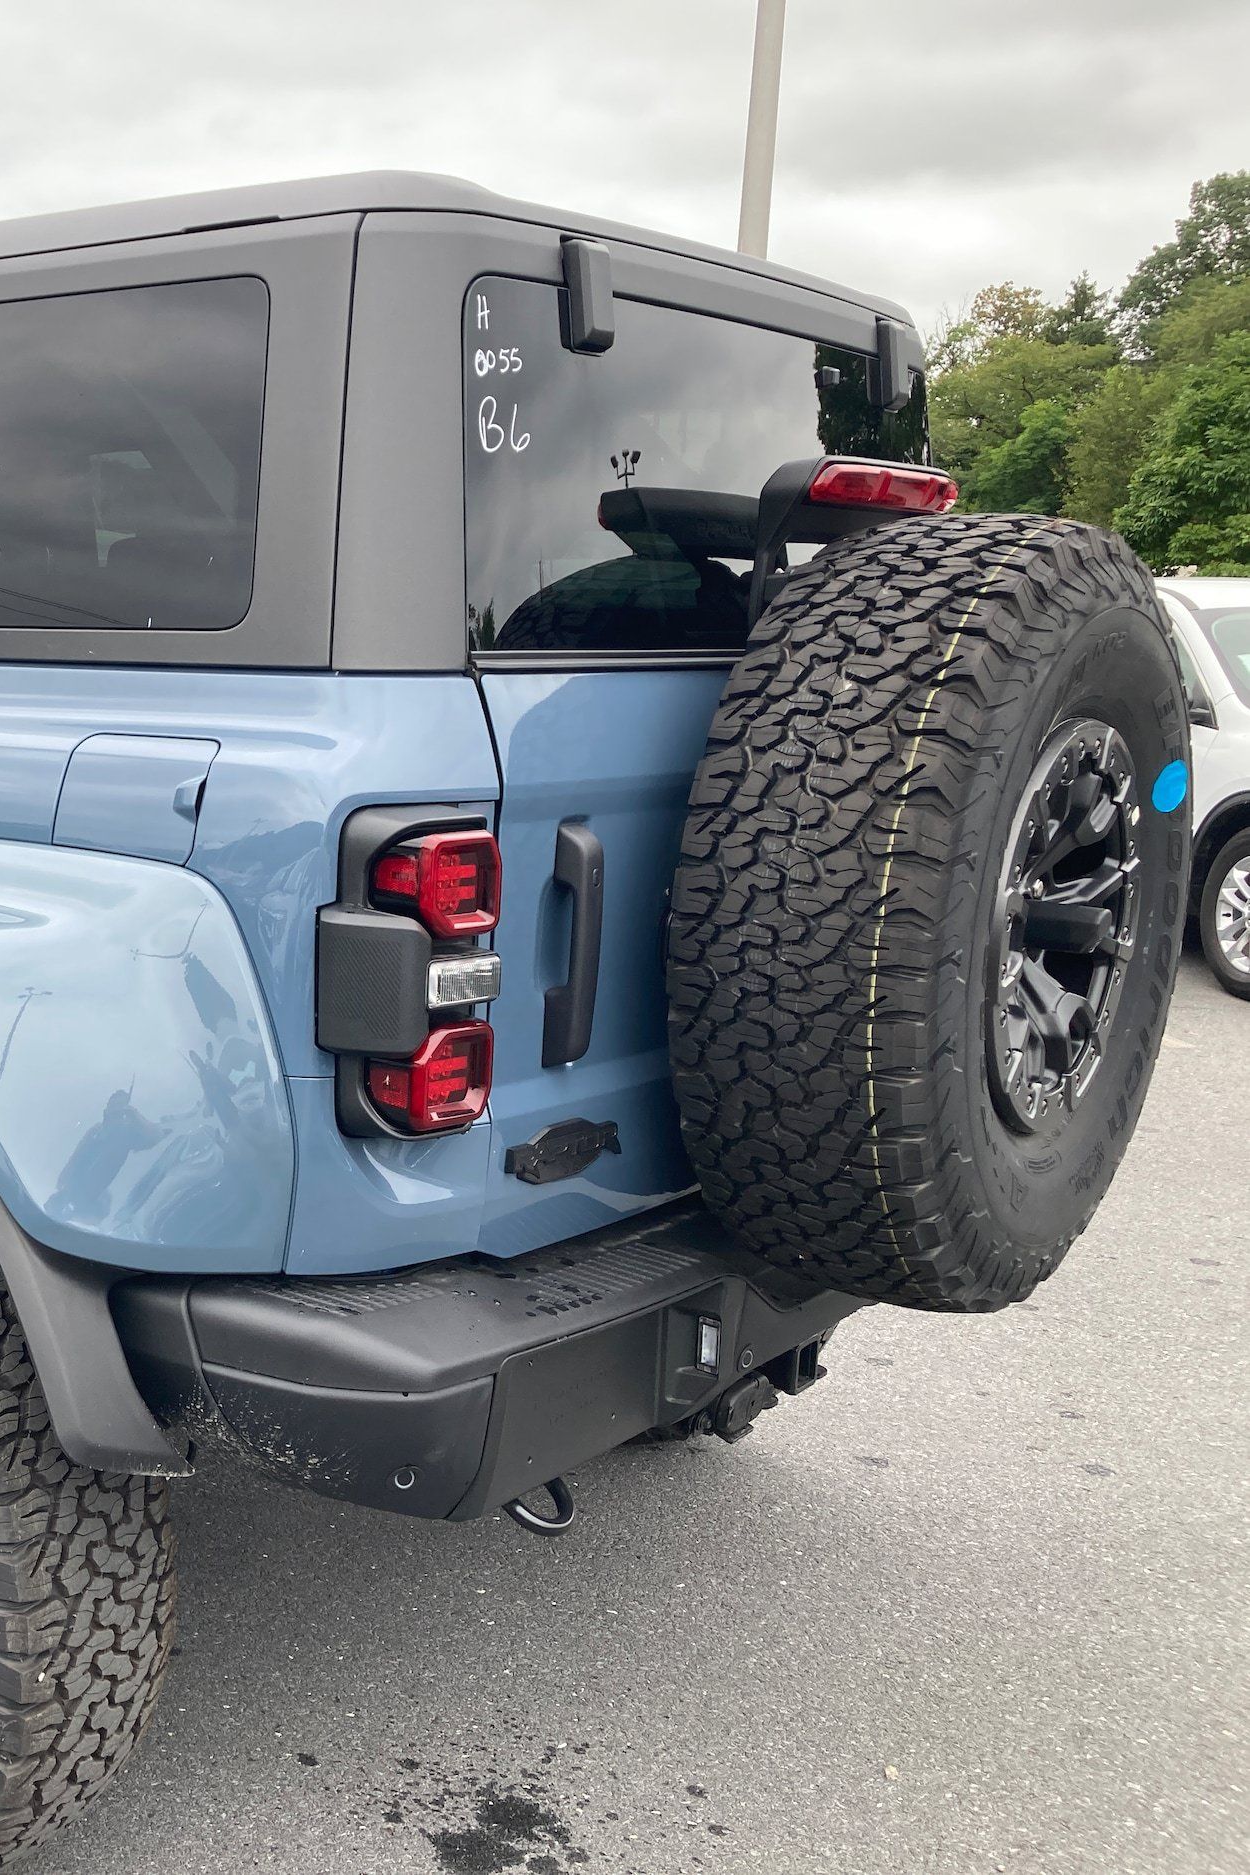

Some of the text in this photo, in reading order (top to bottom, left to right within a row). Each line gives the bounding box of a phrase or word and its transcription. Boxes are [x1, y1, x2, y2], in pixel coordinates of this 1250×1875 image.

[476, 293, 491, 330] H
[478, 395, 531, 452] B6
[1108, 687, 1186, 1141] BFoodrich
